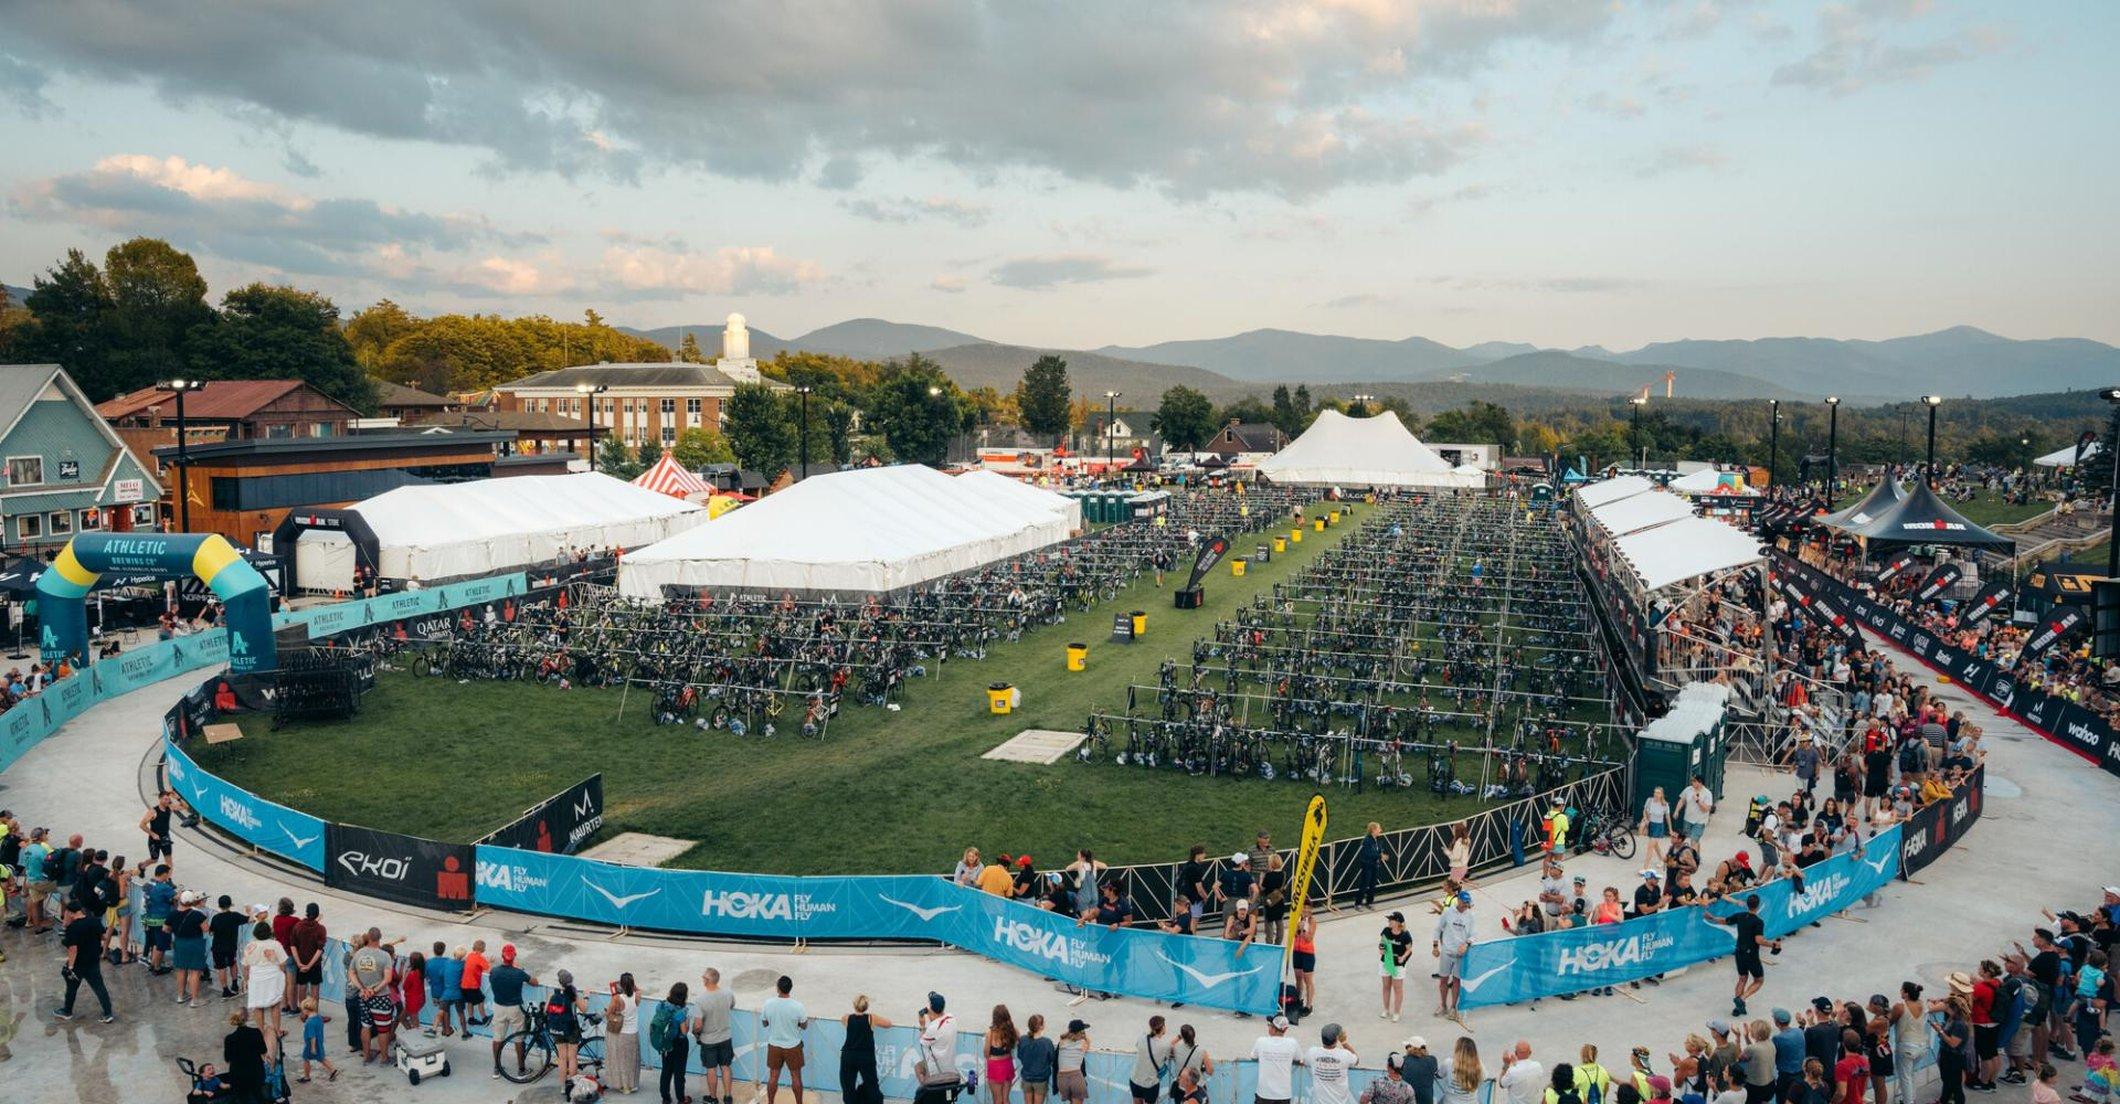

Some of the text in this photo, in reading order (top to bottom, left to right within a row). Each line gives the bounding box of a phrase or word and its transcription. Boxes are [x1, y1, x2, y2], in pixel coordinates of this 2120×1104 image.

[103, 540, 166, 555] ATHLETIC
[314, 611, 344, 625] ATHLETIC
[416, 617, 451, 636] QATAR
[2067, 722, 2099, 746] wahoo
[1291, 831, 1318, 912] CROSSWALK
[702, 890, 793, 920] HOKA
[794, 894, 812, 903] FLY
[1788, 876, 1833, 919] HOKA
[794, 902, 837, 912] HUMAN
[794, 910, 812, 920] FLY
[994, 915, 1070, 965] HOKA
[1070, 937, 1086, 950] FLY
[1641, 931, 1656, 943] FLY
[1641, 936, 1674, 952] HUMAN
[1070, 946, 1111, 964] HUMAN
[1070, 957, 1086, 968] FLY
[1557, 935, 1640, 977] HOKA
[1640, 949, 1655, 961] FLY
